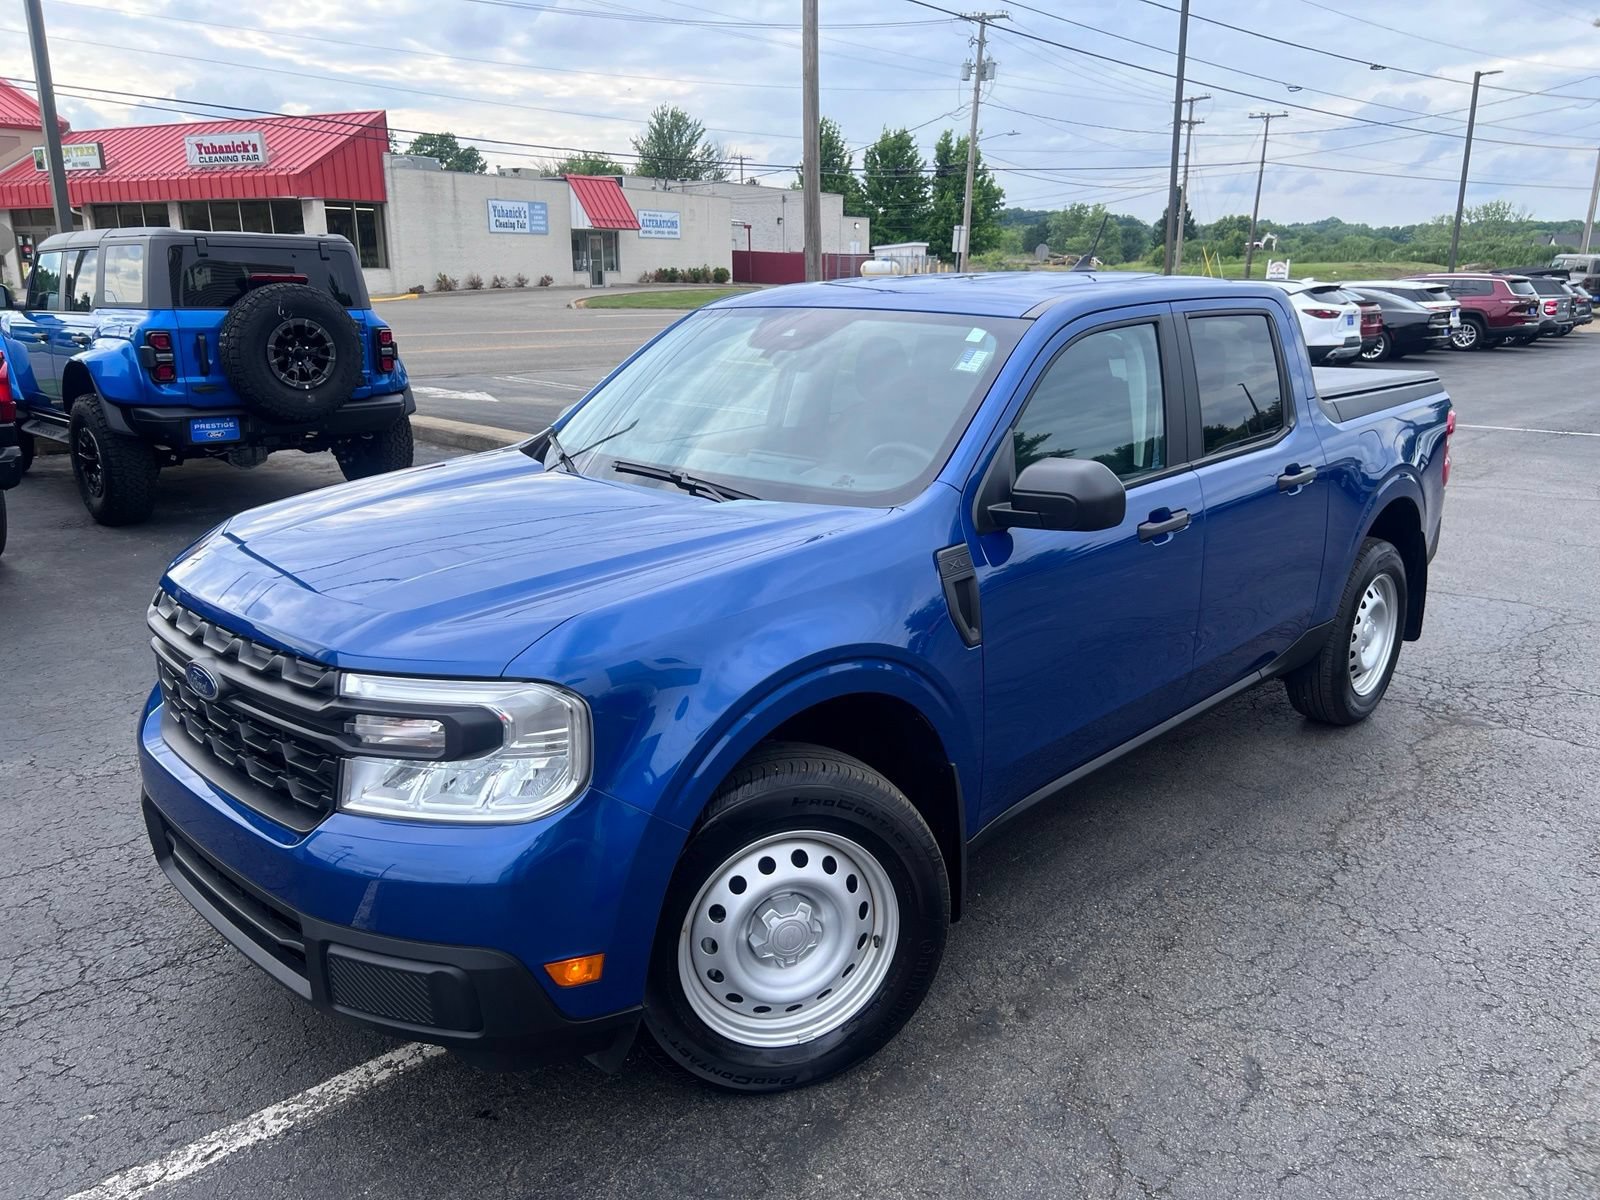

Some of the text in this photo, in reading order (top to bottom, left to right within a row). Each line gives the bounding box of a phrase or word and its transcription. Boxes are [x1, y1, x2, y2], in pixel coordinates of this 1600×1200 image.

[195, 140, 258, 155] Yuhanick's
[199, 154, 259, 163] CLEANING FAIR
[492, 205, 527, 219] Yuhanick's
[495, 219, 515, 231] Cleaning
[517, 220, 526, 229] Fair
[641, 218, 678, 229] ALTERATIONS
[194, 422, 234, 430] PRESTIGE
[948, 559, 967, 570] XL
[190, 669, 210, 694] Ford
